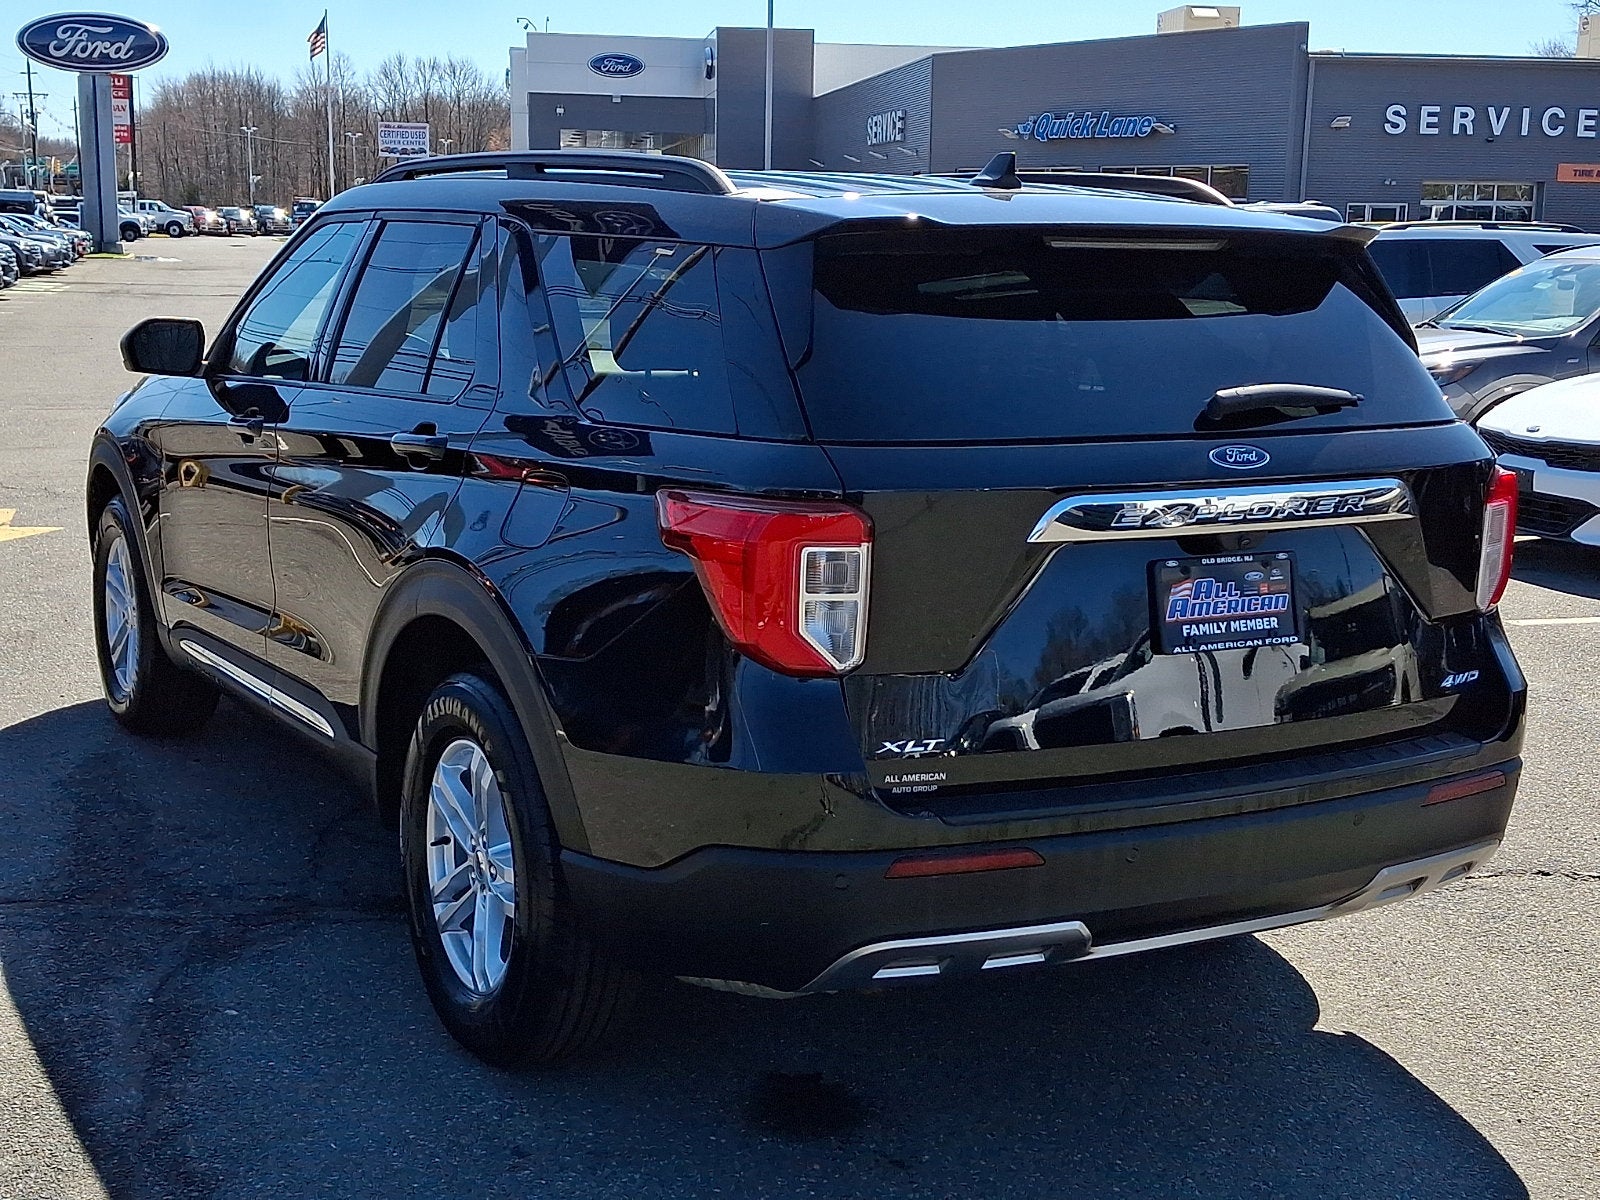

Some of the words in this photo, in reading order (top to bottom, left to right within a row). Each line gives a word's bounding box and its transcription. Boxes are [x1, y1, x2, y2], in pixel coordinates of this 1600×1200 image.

[48, 23, 136, 59] Ford
[600, 57, 632, 72] Ford
[867, 110, 906, 145] SERVICE
[1034, 112, 1097, 142] Quick
[1095, 111, 1154, 138] Lane
[1384, 104, 1599, 138] SERVICE
[380, 130, 409, 139] CERTIFIED
[410, 131, 426, 139] USED
[1226, 447, 1258, 462] Ford
[1110, 494, 1367, 527] EXPLORER
[1182, 621, 1229, 637] FAMILY
[1230, 616, 1279, 632] MEMBER
[1173, 645, 1197, 653] ALL
[1199, 639, 1263, 651] AMERICAN
[1265, 635, 1299, 645] FORD
[1440, 669, 1479, 687] 4WD
[875, 738, 946, 753] XLT
[884, 775, 900, 783] ALL
[901, 772, 946, 782] AMERICAN
[912, 784, 938, 792] GROUP
